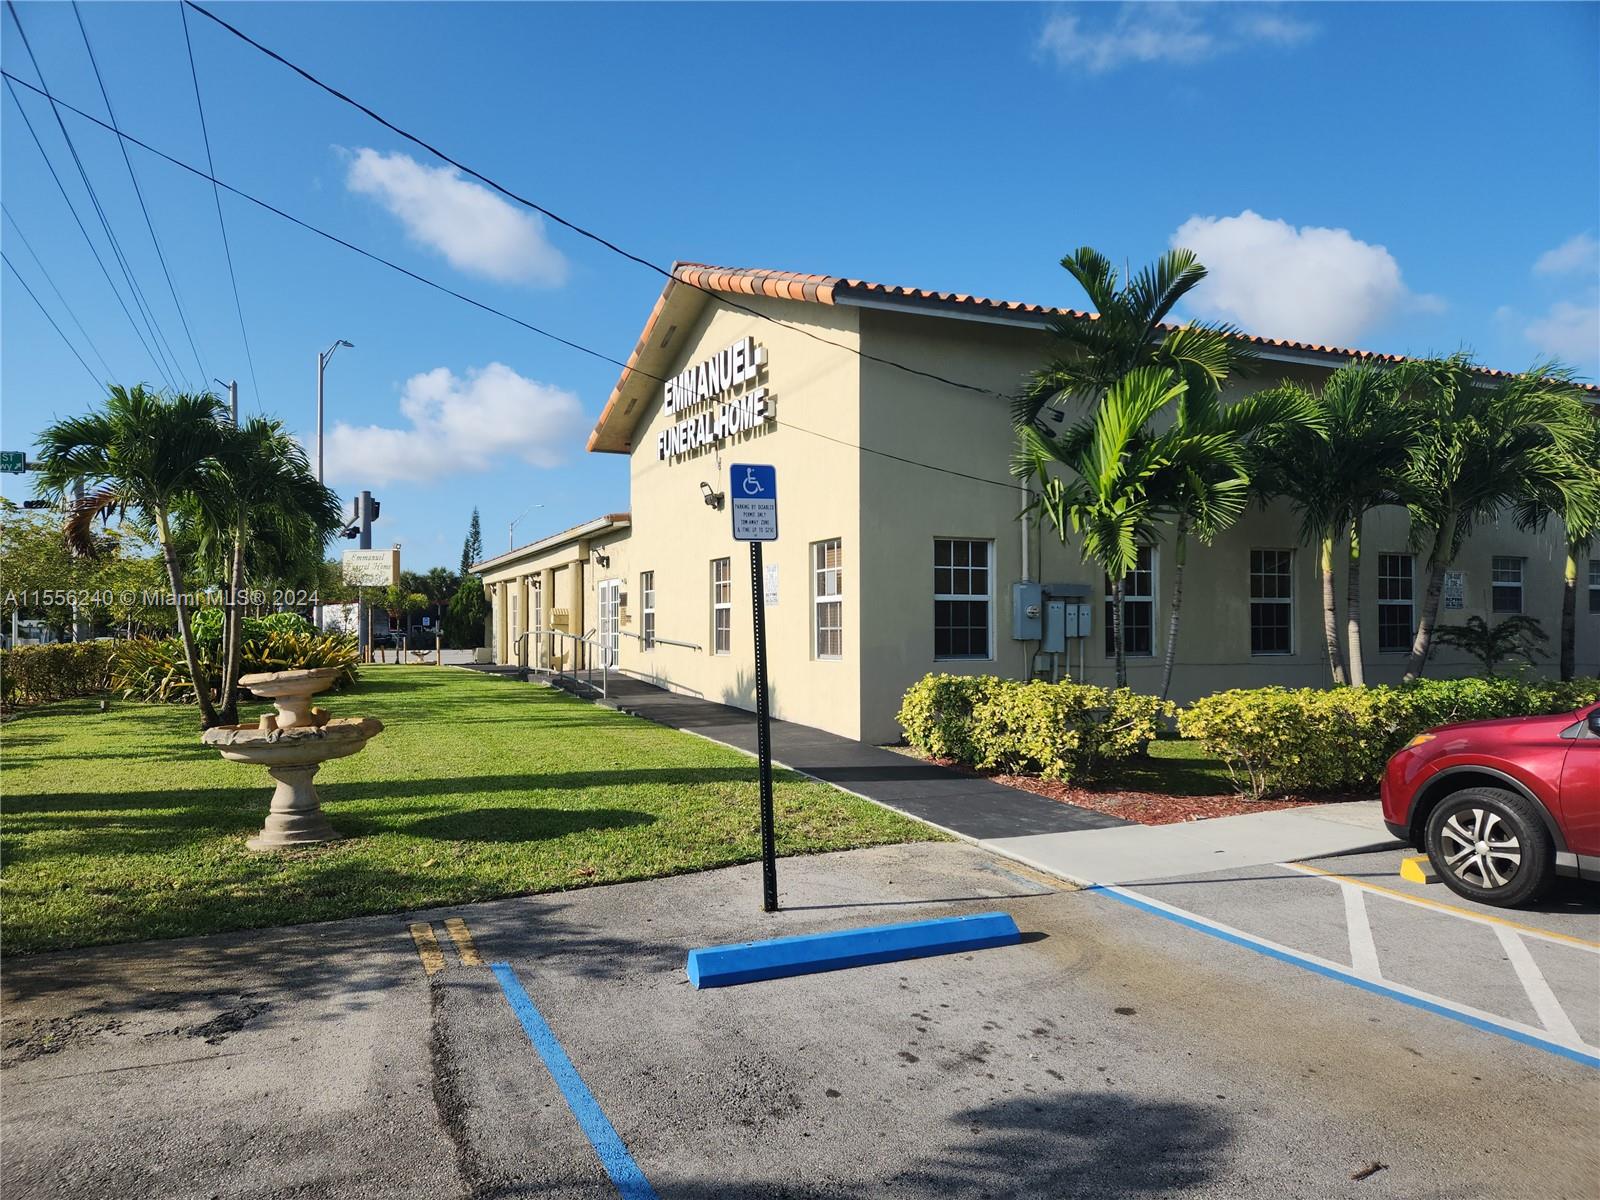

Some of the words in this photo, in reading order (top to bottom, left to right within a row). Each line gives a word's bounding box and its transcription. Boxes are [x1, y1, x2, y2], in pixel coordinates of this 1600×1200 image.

[663, 335, 757, 417] EMMANUEL
[657, 410, 714, 460] FUNERAL
[718, 387, 766, 440] HOME
